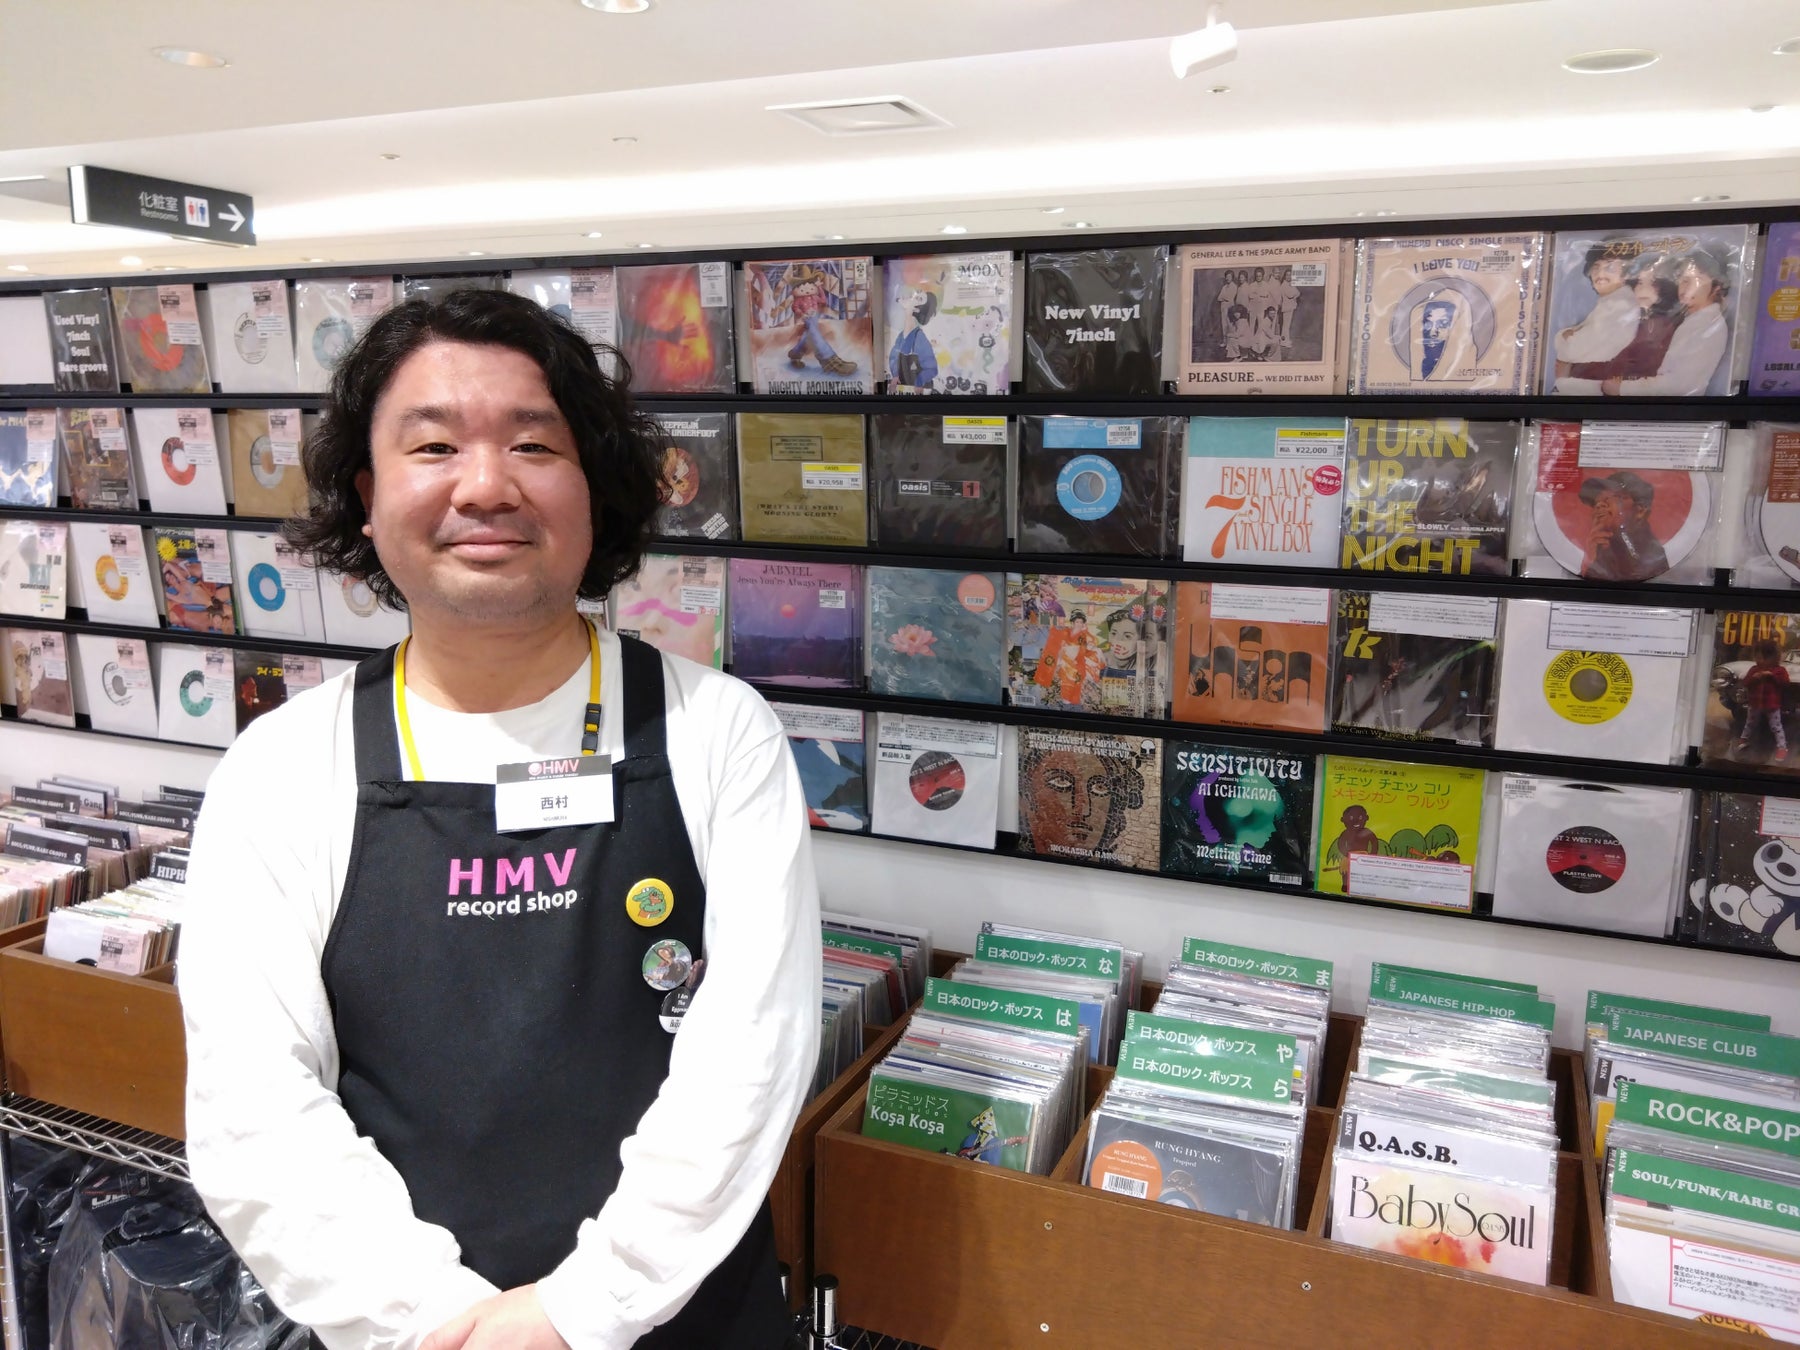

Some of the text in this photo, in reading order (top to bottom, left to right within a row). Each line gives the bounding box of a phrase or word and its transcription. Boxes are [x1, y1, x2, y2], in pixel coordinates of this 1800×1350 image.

[139, 191, 179, 212] 化粧室
[141, 207, 179, 222] Restrooms
[1435, 238, 1464, 248] DISCO
[1468, 236, 1503, 246] SINGLE
[1190, 245, 1331, 260] GENERAL LEE & THE SPACE ARMY BAND
[1413, 257, 1480, 274] I LOVE YOU
[55, 313, 99, 327] Used Vinyl
[1045, 303, 1140, 321] New Vinyl
[1362, 294, 1374, 341] DISCO
[1515, 292, 1529, 341] DISCO
[66, 330, 90, 343] 7inch
[1066, 327, 1116, 343] 7inch
[70, 346, 90, 357] Soul
[58, 361, 108, 375] Rare groove
[1188, 372, 1255, 383] PLEASURE
[768, 381, 864, 395] MIGHTY MOUNTAINS
[960, 433, 987, 441] ¥43,000
[1352, 419, 1470, 458] TURN
[901, 483, 928, 493] oasis
[1348, 460, 1404, 497] UP
[1248, 496, 1314, 526] SINGLE
[1345, 499, 1418, 533] THE
[1205, 494, 1246, 560] 7
[1417, 523, 1450, 531] SLOWLY
[1233, 521, 1313, 553] VINYL BOX
[1342, 535, 1480, 575] NIGHT
[737, 576, 758, 584] Jesus
[787, 579, 816, 589] Always
[819, 579, 842, 588] There
[1723, 612, 1788, 647] GUNS
[1551, 653, 1579, 679] SUN
[1598, 653, 1629, 683] SHOT
[1029, 741, 1130, 759] SYMPATHY FOR THE DEVIL
[543, 758, 579, 775] HMV
[1177, 751, 1303, 780] SENSITIVITY
[1198, 783, 1277, 802] AI ICHIKAWA
[1332, 788, 1450, 810] メキシカン ワルツ
[1424, 782, 1451, 797] コリ
[69, 801, 76, 813] L
[540, 795, 568, 810] 西村
[182, 817, 190, 828] P
[111, 838, 120, 849] R
[1572, 836, 1593, 844] WEST
[74, 852, 82, 864] S
[1196, 845, 1272, 864] Melting Time
[157, 864, 187, 881] HIPH
[449, 848, 577, 896] HMV
[447, 889, 577, 917] record shop
[988, 946, 1114, 975] 日本のロック・ポップス な
[1194, 950, 1331, 987] 日本のロック・ポップス ま
[1389, 976, 1397, 993] NEW
[937, 991, 1072, 1027] 日本のロック・ポップス は
[1399, 990, 1516, 1019] JAPANESE HIP-HOP
[1590, 992, 1598, 1009] NEW
[1612, 1013, 1620, 1030] NEW
[1624, 1027, 1758, 1058] JAPANESE CLUB
[1277, 1043, 1294, 1063] や
[1132, 1056, 1289, 1099] 日本のロック・ポップス ら
[1600, 1060, 1609, 1080] NEW
[874, 1085, 949, 1112] ピラミッドス
[1620, 1083, 1629, 1103] NEW
[1344, 1114, 1354, 1136] NEW
[1113, 1149, 1148, 1162] RUNG HYANG
[1154, 1140, 1222, 1163] RUNG HYANG
[1358, 1131, 1458, 1165] Q.A.S.B.
[1172, 1156, 1197, 1168] Trapped
[1619, 1150, 1628, 1173] NEW
[1632, 1169, 1773, 1210] SOUL/FUNK/RARE
